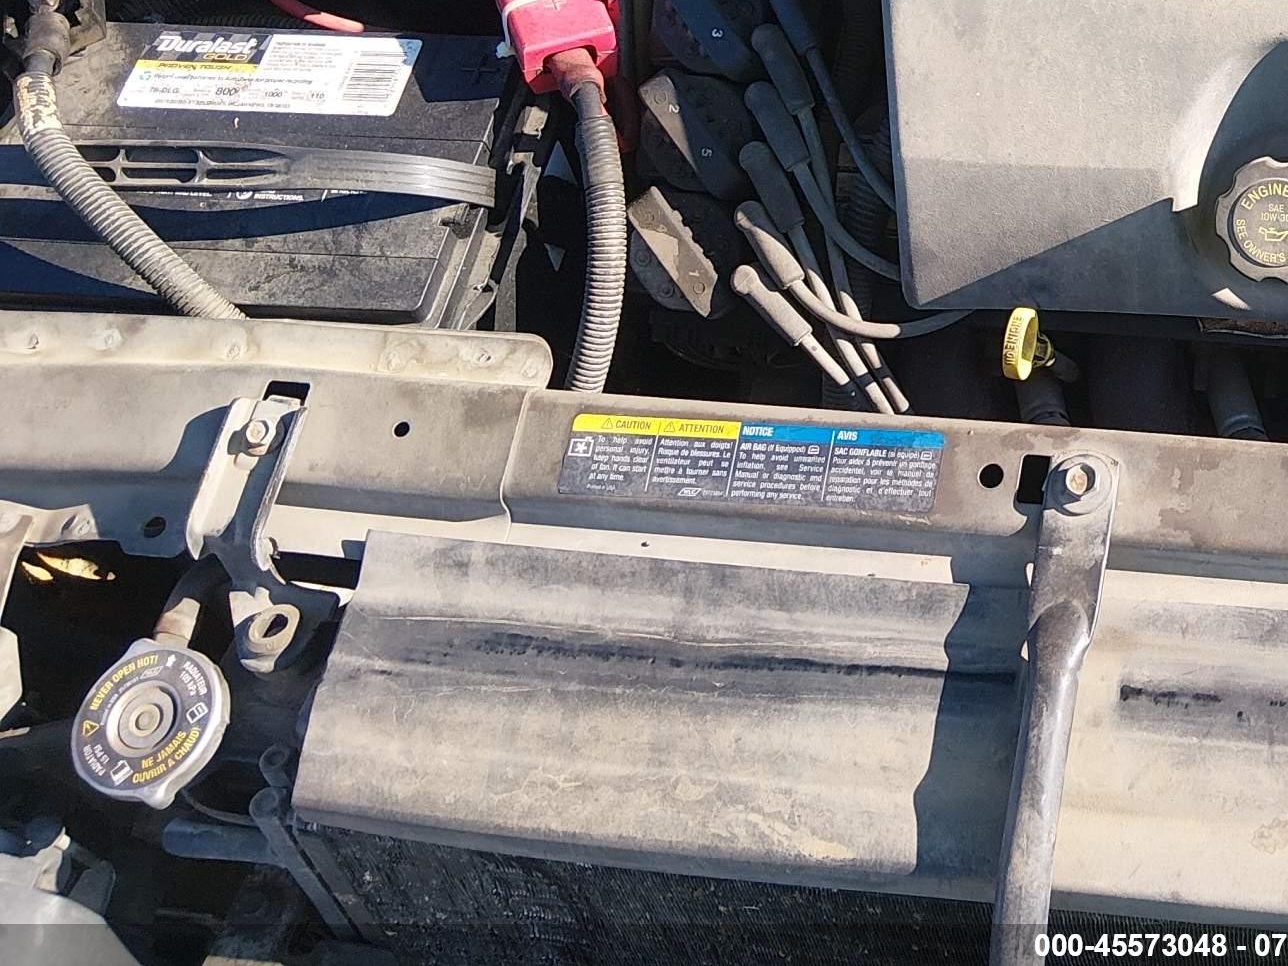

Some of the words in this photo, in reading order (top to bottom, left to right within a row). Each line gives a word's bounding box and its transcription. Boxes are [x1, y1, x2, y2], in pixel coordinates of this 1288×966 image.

[712, 29, 723, 37] 3
[156, 35, 258, 54] Duralast
[216, 87, 240, 96] 800
[669, 104, 679, 113] 2
[702, 148, 712, 157] 5
[1269, 204, 1285, 212] SAE
[1237, 219, 1248, 239] SEE
[1243, 240, 1286, 262] OWNER'S
[616, 419, 651, 430] CAUTION
[678, 424, 725, 434] ATTENTION
[743, 425, 774, 437] NOTICE
[837, 431, 858, 441] AVIS
[598, 435, 606, 443] To
[613, 436, 627, 445] help
[660, 438, 689, 447] Attention
[711, 441, 733, 450] doigts!
[595, 445, 624, 453] personal
[658, 447, 680, 456] Risque
[690, 449, 721, 458] blessures.
[723, 451, 731, 459] Le
[740, 442, 752, 451] AIR
[754, 443, 766, 451] BAG
[776, 444, 805, 454] Equipped)
[835, 447, 848, 456] SAC
[849, 448, 886, 458] GONFLABLE
[593, 454, 609, 463] keep
[612, 454, 630, 462] hands
[656, 457, 690, 465] ventilateur
[698, 459, 713, 468] peut
[752, 453, 766, 462] help
[771, 454, 789, 462] avoid
[794, 455, 825, 464] unwanted
[833, 457, 846, 465] Pour
[849, 458, 864, 467] aider
[909, 461, 936, 471] gonflage
[655, 466, 676, 474] mettre
[686, 468, 708, 476] tourner
[799, 464, 823, 472] Service
[870, 468, 883, 477] voir
[898, 470, 922, 478] manuel
[926, 471, 934, 479] de
[597, 474, 608, 482] any
[652, 476, 697, 484] avertissement.
[735, 470, 759, 479] Manual
[774, 472, 806, 482] diagnostic
[733, 480, 756, 488] service
[760, 482, 796, 491] procedures
[800, 483, 820, 491] before
[863, 477, 878, 487] pour
[880, 477, 889, 485] les
[925, 480, 933, 488] de
[731, 489, 765, 500] performing
[767, 491, 778, 501] any
[779, 492, 802, 500] service.
[828, 484, 860, 494] diagnostic
[878, 486, 913, 496] d'effectuer
[919, 488, 932, 497] tout
[89, 681, 114, 711] NEVER
[113, 662, 136, 682] OPEN
[136, 655, 159, 669] HOT!
[184, 661, 208, 695] RADIATEUR
[142, 758, 154, 769] NE
[156, 730, 187, 762] JAMAIS
[132, 762, 167, 783] OUVRIR
